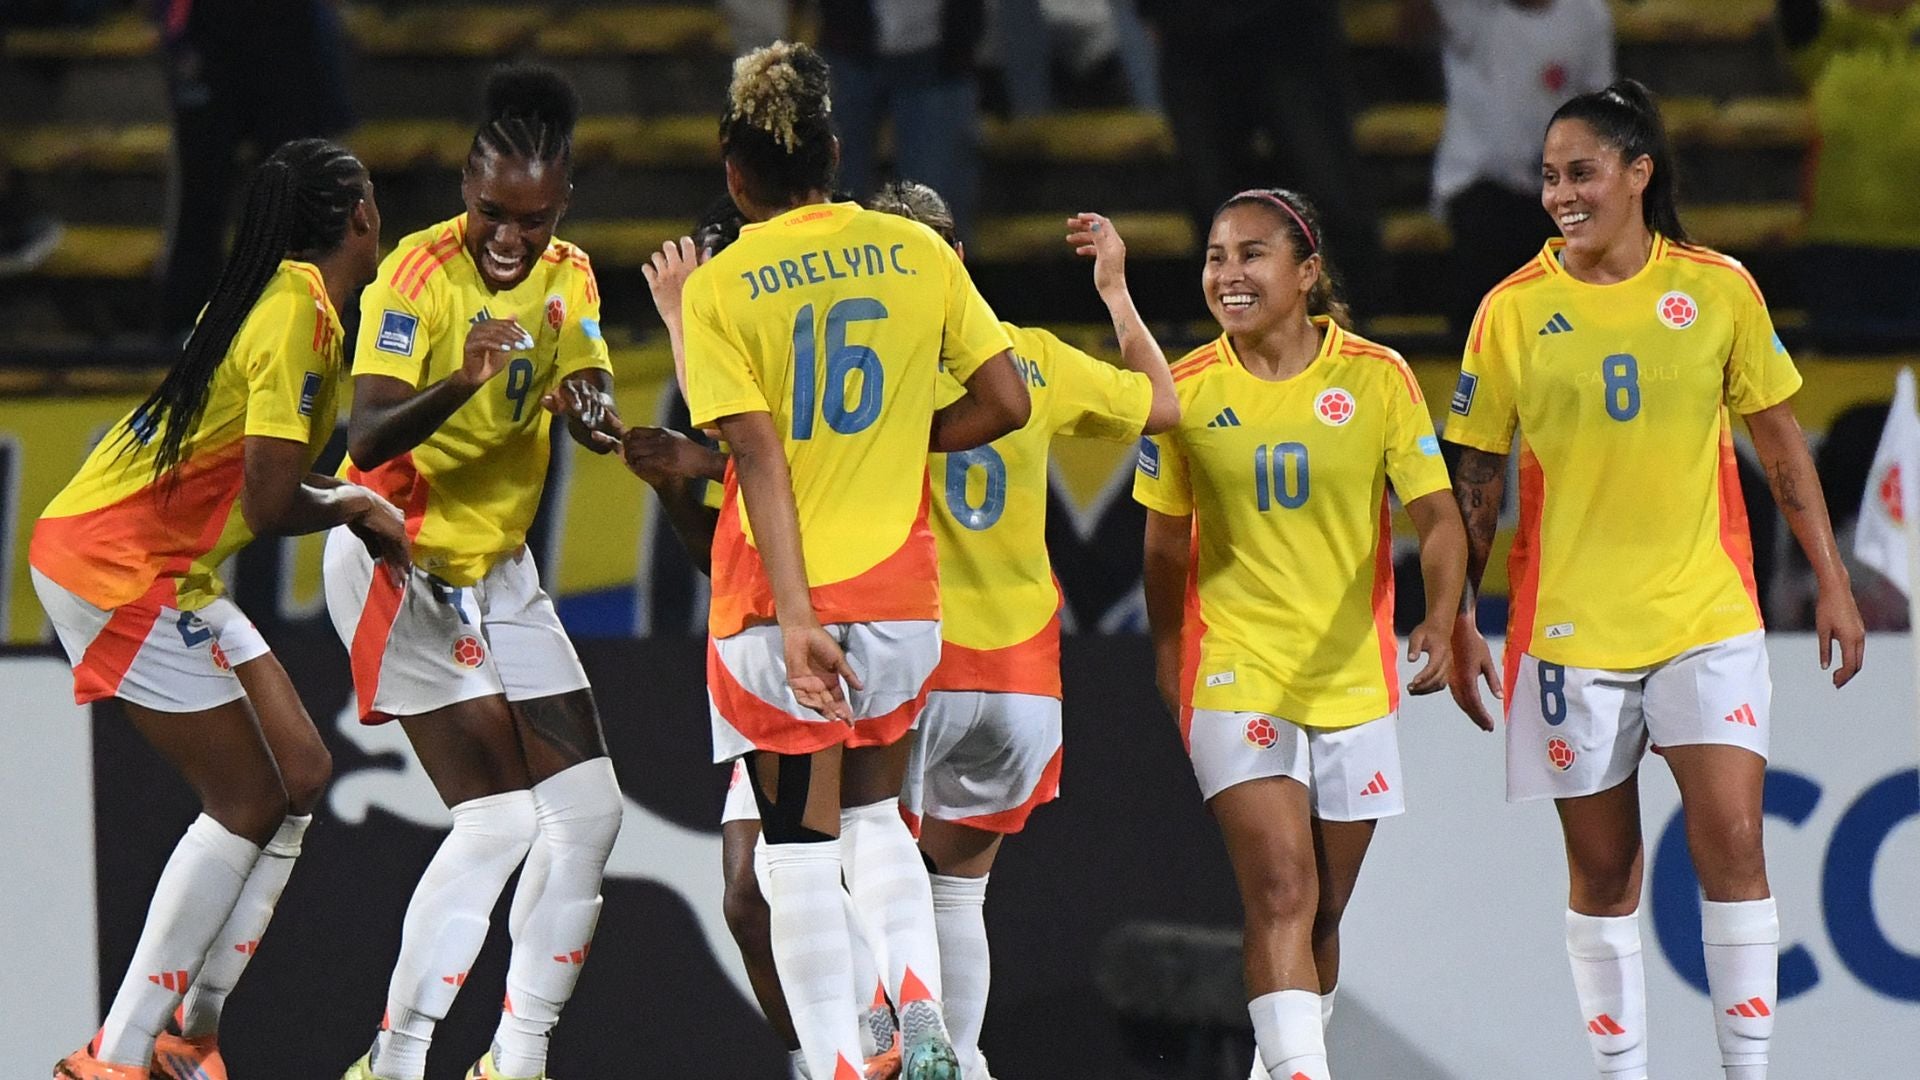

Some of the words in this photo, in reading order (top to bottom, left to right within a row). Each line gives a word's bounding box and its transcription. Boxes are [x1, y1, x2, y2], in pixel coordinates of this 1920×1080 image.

[506, 358, 533, 421] 9
[792, 297, 889, 441] 16
[1603, 353, 1641, 422] 8
[1254, 441, 1310, 512] 10
[1538, 659, 1567, 727] 8
